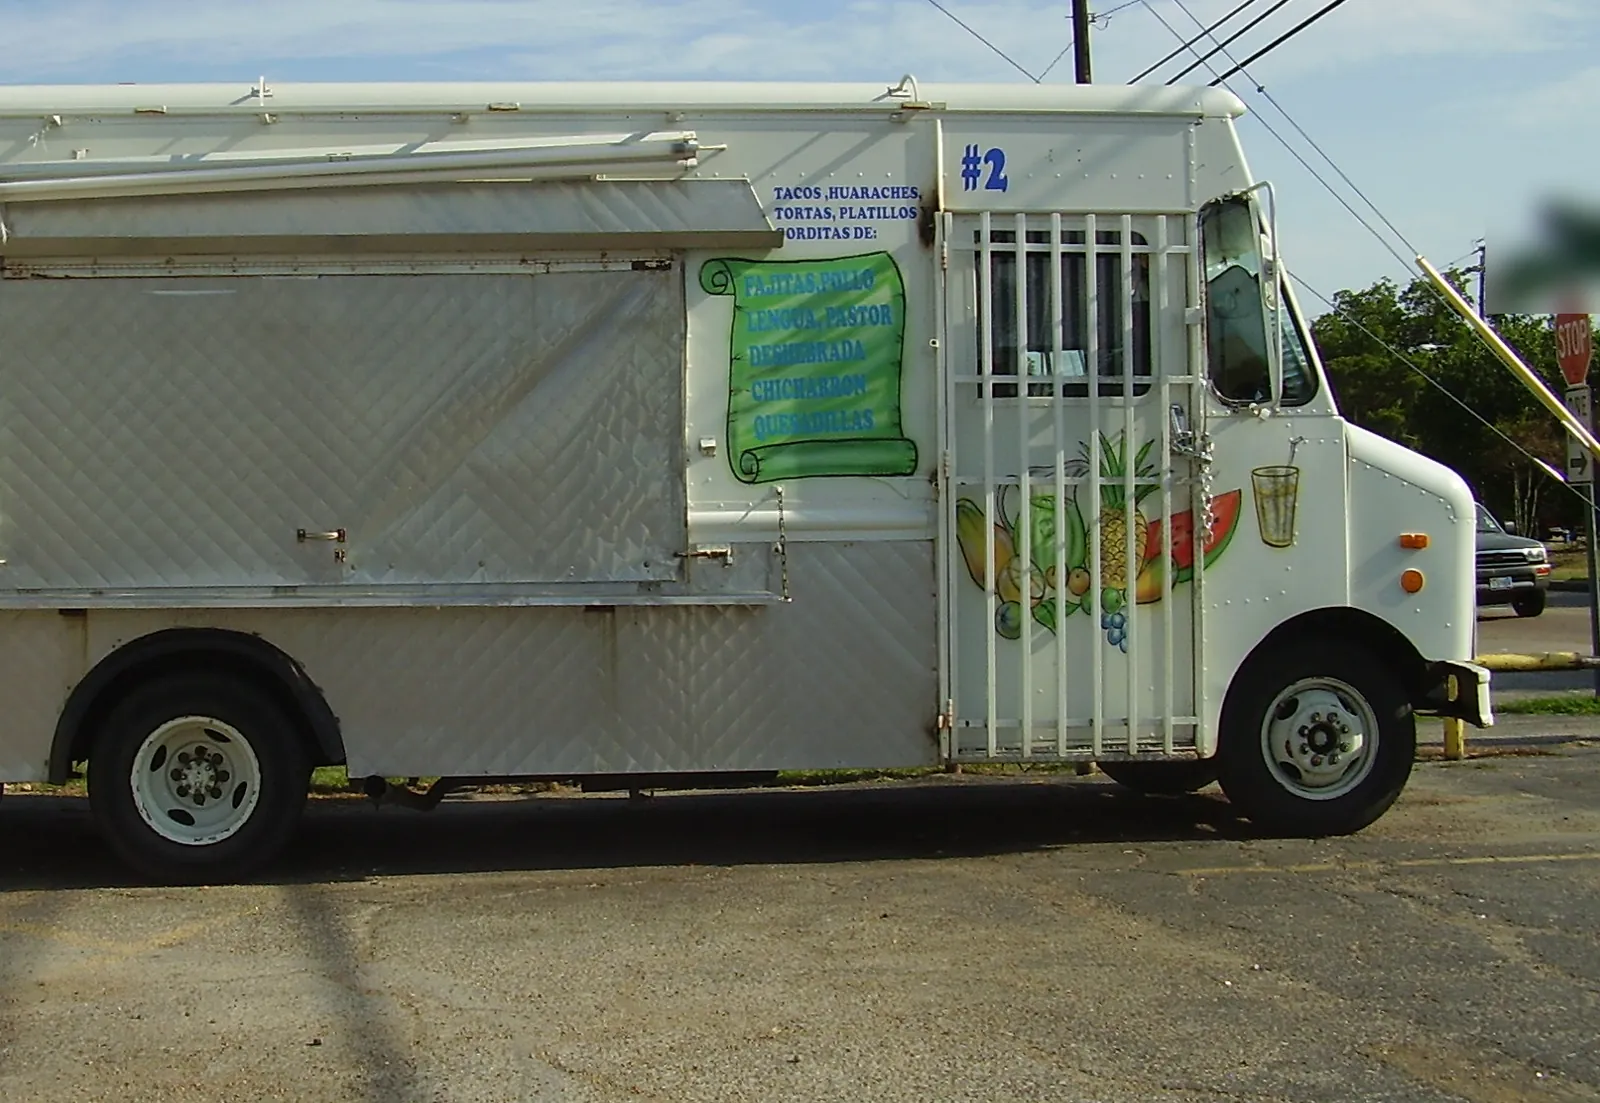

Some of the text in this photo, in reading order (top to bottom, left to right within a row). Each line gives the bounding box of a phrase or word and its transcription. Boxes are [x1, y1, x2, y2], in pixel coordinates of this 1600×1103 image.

[961, 143, 1008, 193] #2
[773, 187, 821, 200] TACOS
[774, 207, 836, 222] TORTAS,
[839, 206, 917, 220] PLATILLOS
[853, 227, 877, 240] DE:
[825, 304, 893, 327] PASTOR
[1557, 318, 1588, 359] STOP
[752, 373, 867, 402] CHICHARRON
[754, 408, 875, 442] QUESADILLAS
